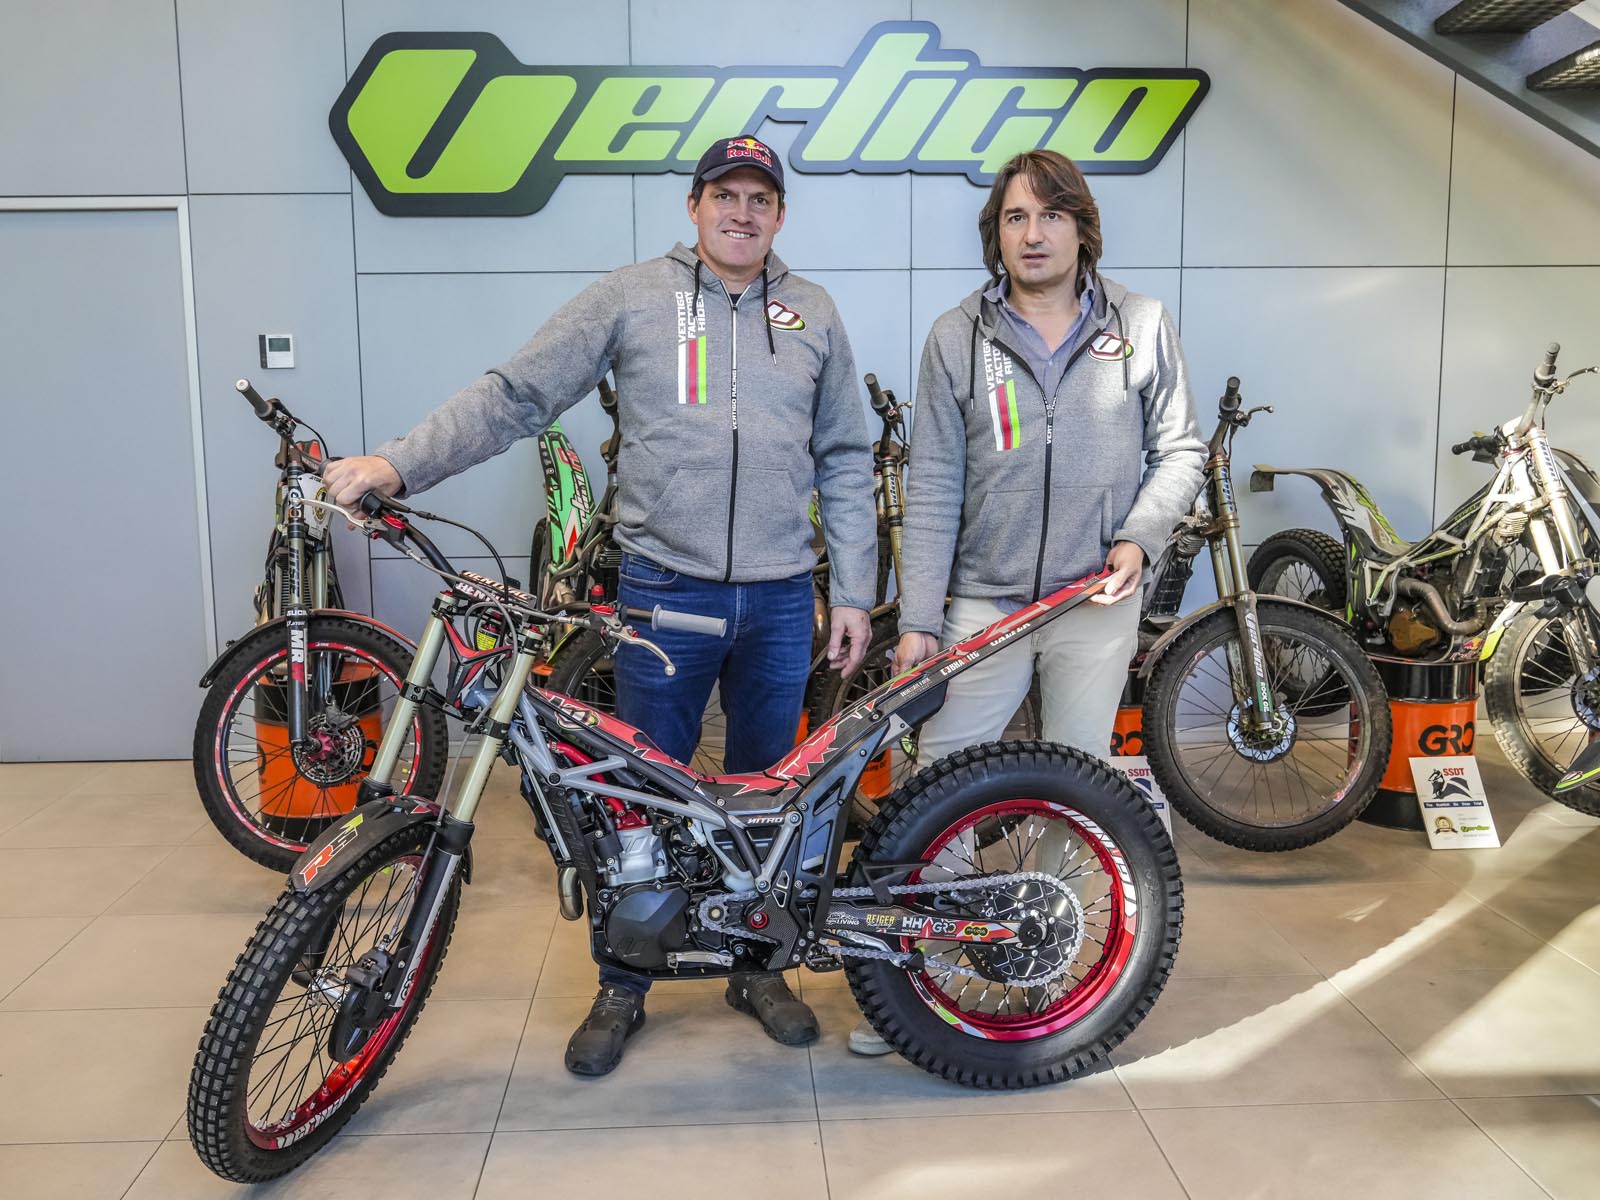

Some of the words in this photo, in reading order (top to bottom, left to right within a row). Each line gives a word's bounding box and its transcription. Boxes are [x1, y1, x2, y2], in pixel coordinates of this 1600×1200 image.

[346, 32, 1200, 195] Vertigo
[727, 147, 751, 158] Red
[752, 149, 772, 168] Bull
[675, 291, 687, 342] VERTIGO
[982, 338, 996, 391] VERTIGO
[992, 346, 1005, 384] FACTO
[1127, 768, 1150, 777] SSDT
[1443, 767, 1465, 776] SSDT
[866, 913, 895, 925] REIGER
[902, 916, 923, 929] HH
